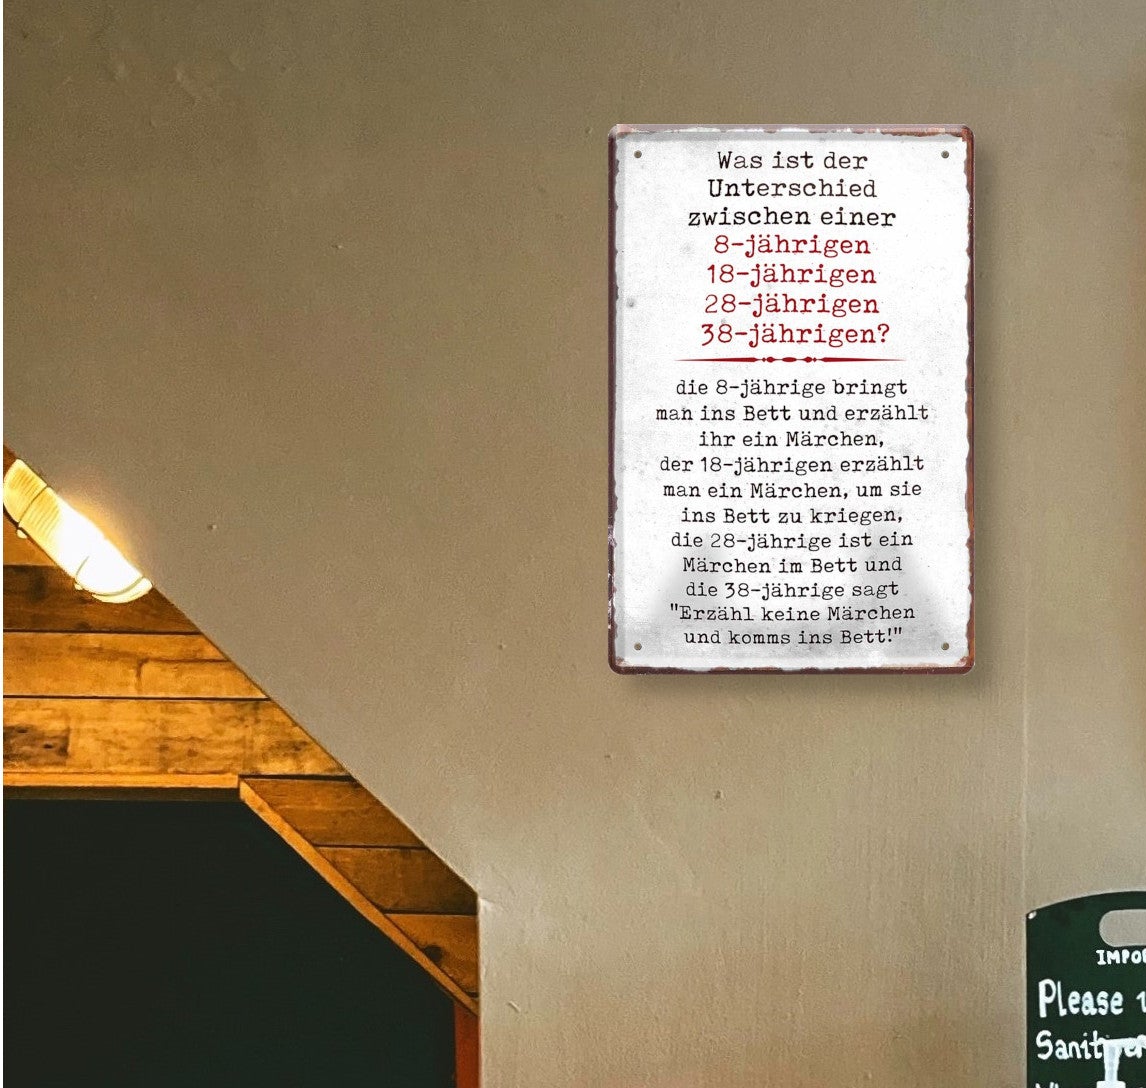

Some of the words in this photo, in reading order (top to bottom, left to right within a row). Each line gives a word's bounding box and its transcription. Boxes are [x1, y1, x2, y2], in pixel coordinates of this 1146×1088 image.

[717, 150, 763, 169] Was
[772, 150, 814, 169] ist
[823, 151, 868, 170] der
[707, 178, 878, 198] Unterschied
[688, 206, 812, 227] zwischen
[820, 206, 897, 227] einer
[714, 234, 871, 259] 8-jährigen
[707, 263, 877, 288] 18-jährigen
[705, 293, 880, 318] 28-jährigen
[701, 323, 890, 348] 38-jährigen?
[676, 379, 708, 395] die
[715, 379, 826, 399] 8-jährige
[832, 379, 908, 399] bringt
[655, 407, 694, 421] man
[700, 405, 736, 421] ins
[742, 405, 791, 421] Bett
[798, 405, 838, 421] und
[844, 404, 929, 421] erzählt
[699, 430, 736, 447] ihr
[742, 431, 779, 447] ein
[785, 430, 884, 448] Märchen,
[660, 456, 694, 472] der
[700, 456, 833, 476] 18-jährigen
[840, 455, 924, 472] erzählt
[663, 485, 701, 498] man
[707, 482, 743, 498] ein
[750, 482, 848, 500] Märchen,
[856, 485, 883, 497] um
[890, 480, 922, 497] sie
[681, 507, 716, 523] ins
[723, 508, 770, 524] Bett
[778, 512, 803, 524] zu
[810, 507, 903, 526] kriegen,
[671, 531, 703, 548] die
[710, 533, 832, 553] 28-jährige
[838, 532, 872, 548] ist
[879, 531, 914, 547] ein
[682, 557, 772, 574] Märchen
[778, 558, 803, 574] im
[810, 557, 858, 573] Bett
[864, 556, 903, 572] und
[686, 581, 718, 597] die
[724, 582, 845, 601] 38-jährige
[852, 580, 899, 600] sagt
[670, 602, 755, 621] "Erzähl
[761, 606, 820, 622] keine
[827, 605, 916, 621] Märchen
[683, 630, 722, 644] und
[728, 630, 791, 645] komms
[797, 630, 833, 645] ins
[839, 626, 902, 644] Bett!"
[1038, 978, 1124, 1018] Please
